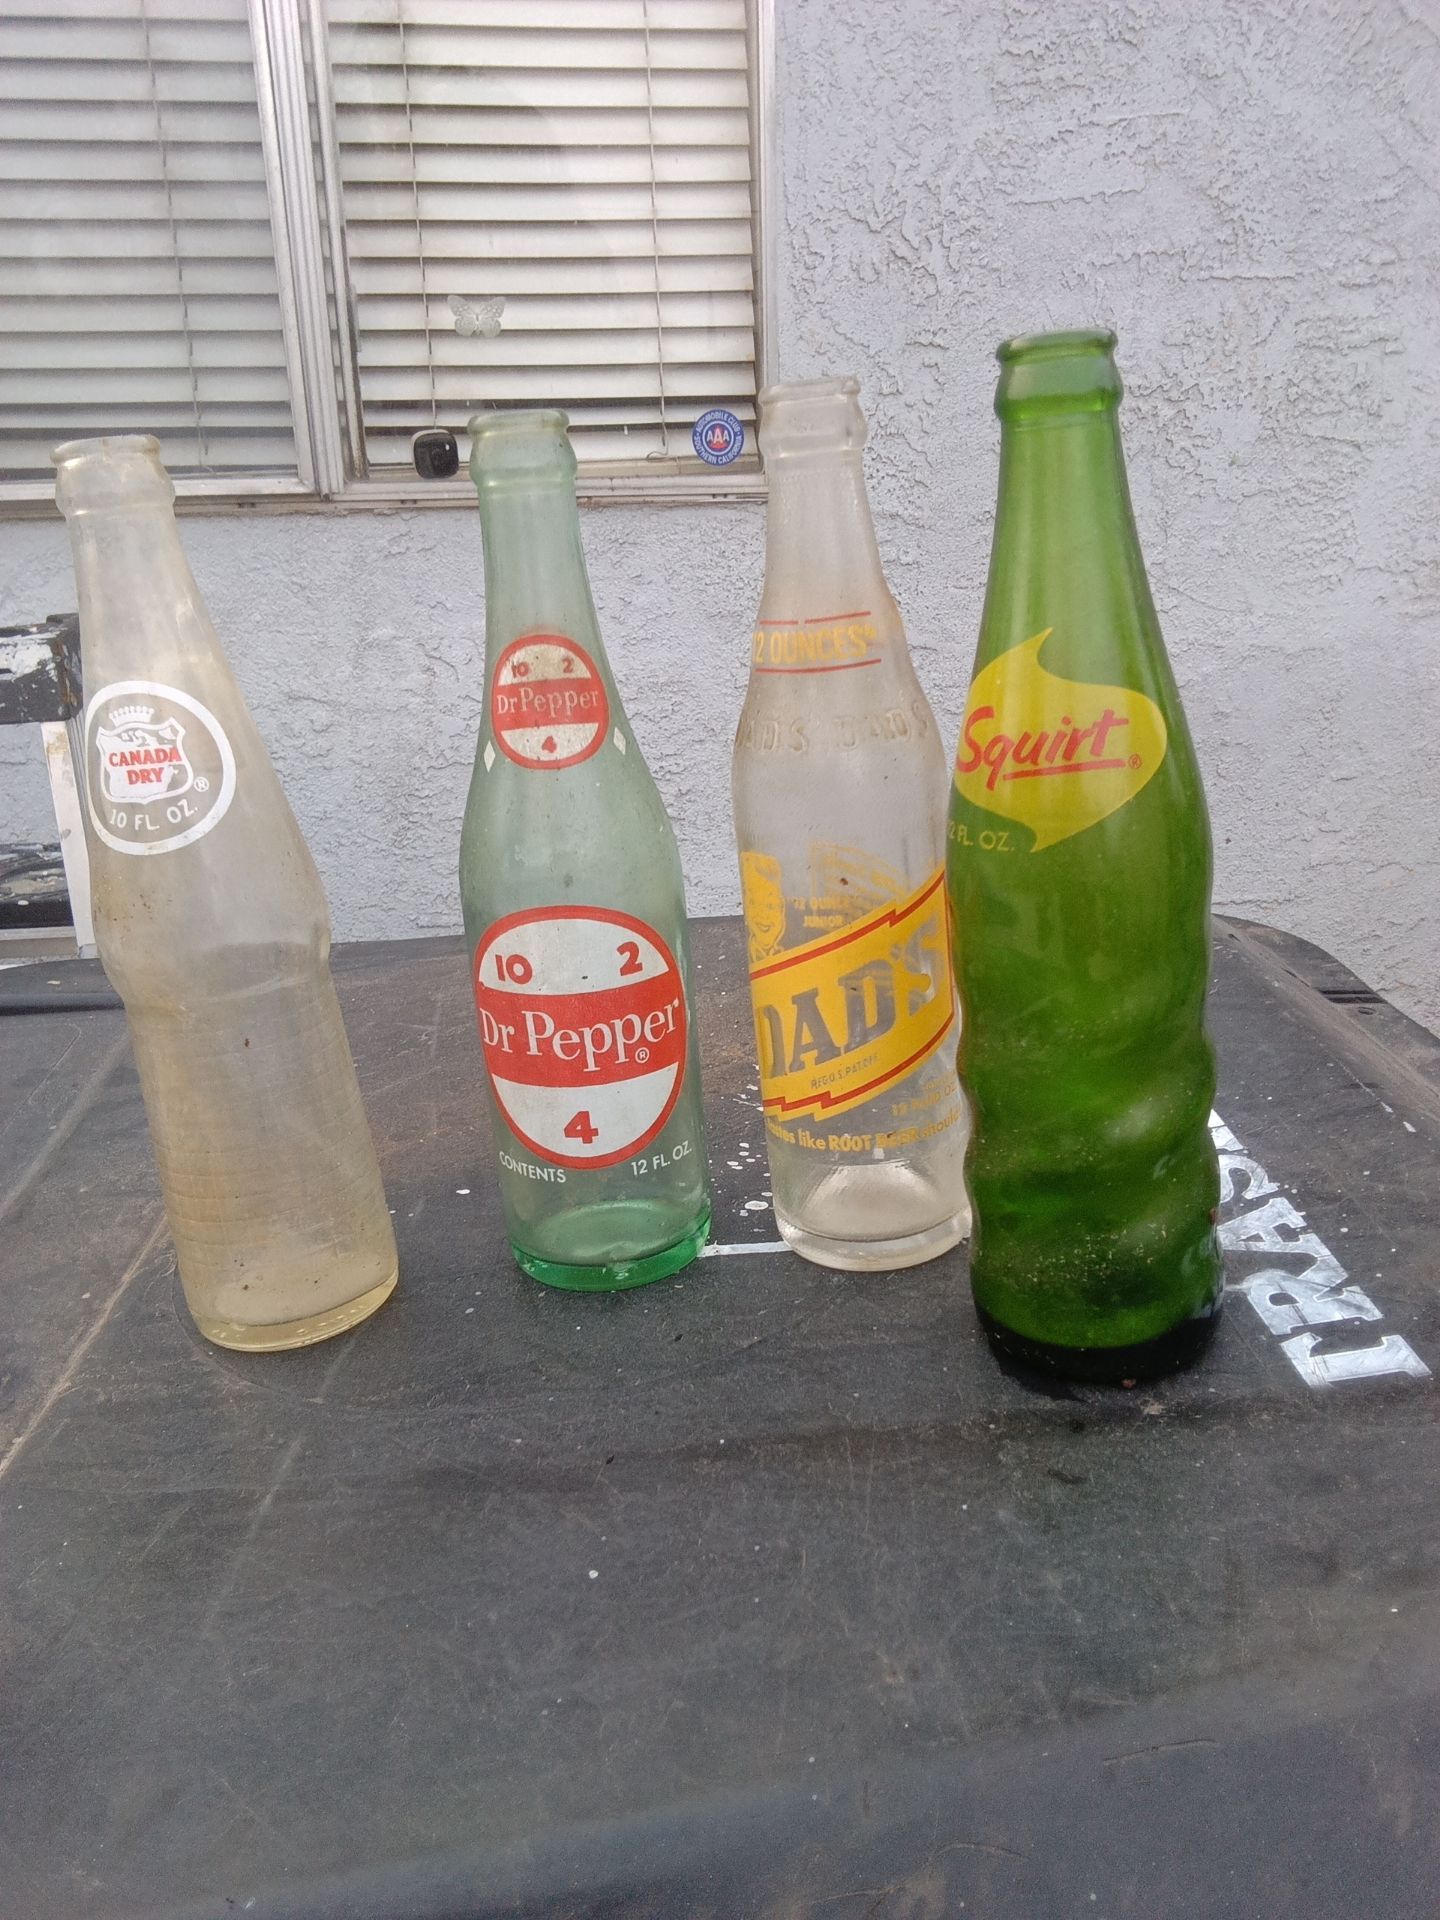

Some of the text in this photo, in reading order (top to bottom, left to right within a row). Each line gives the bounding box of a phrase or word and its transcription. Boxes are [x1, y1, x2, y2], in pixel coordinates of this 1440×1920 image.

[706, 427, 730, 444] AAA
[769, 623, 869, 665] OUNCES
[511, 656, 575, 679] 10 2
[496, 686, 599, 719] Dr Pepper
[108, 745, 183, 767] CANADA
[541, 735, 558, 754] 4
[957, 705, 1130, 792] Squirt
[126, 767, 165, 786] DRY
[109, 798, 199, 831] 10 FL OZ.
[978, 829, 1016, 852] OZ.
[495, 941, 644, 985] 10 2
[479, 1007, 515, 1053] Dr
[521, 998, 680, 1073] Pepper
[563, 1110, 600, 1145] 4
[797, 1127, 827, 1151] like
[827, 1133, 872, 1153] ROOT
[873, 1128, 920, 1149] BEER
[498, 1140, 694, 1184] CONTENTS 12 FL. OZ.
